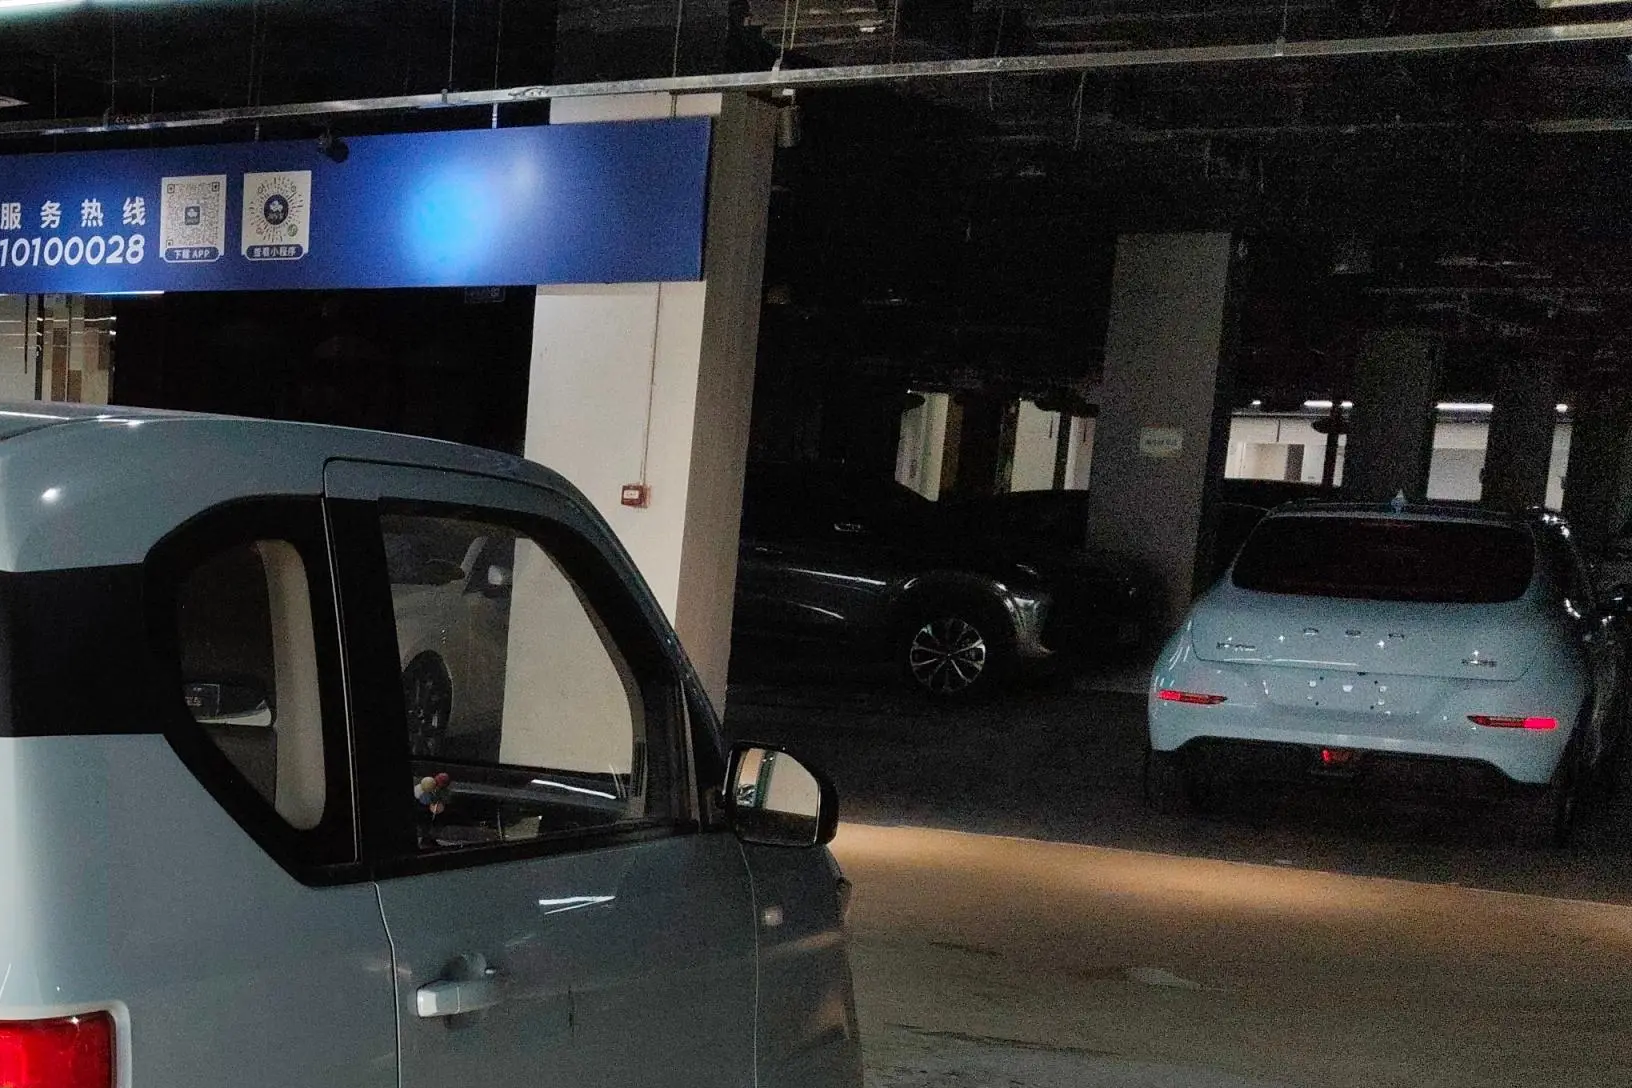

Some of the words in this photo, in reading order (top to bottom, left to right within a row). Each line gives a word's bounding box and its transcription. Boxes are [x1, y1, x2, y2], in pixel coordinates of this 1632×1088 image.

[0, 197, 146, 230] 服务热线
[0, 234, 146, 267] 10100028
